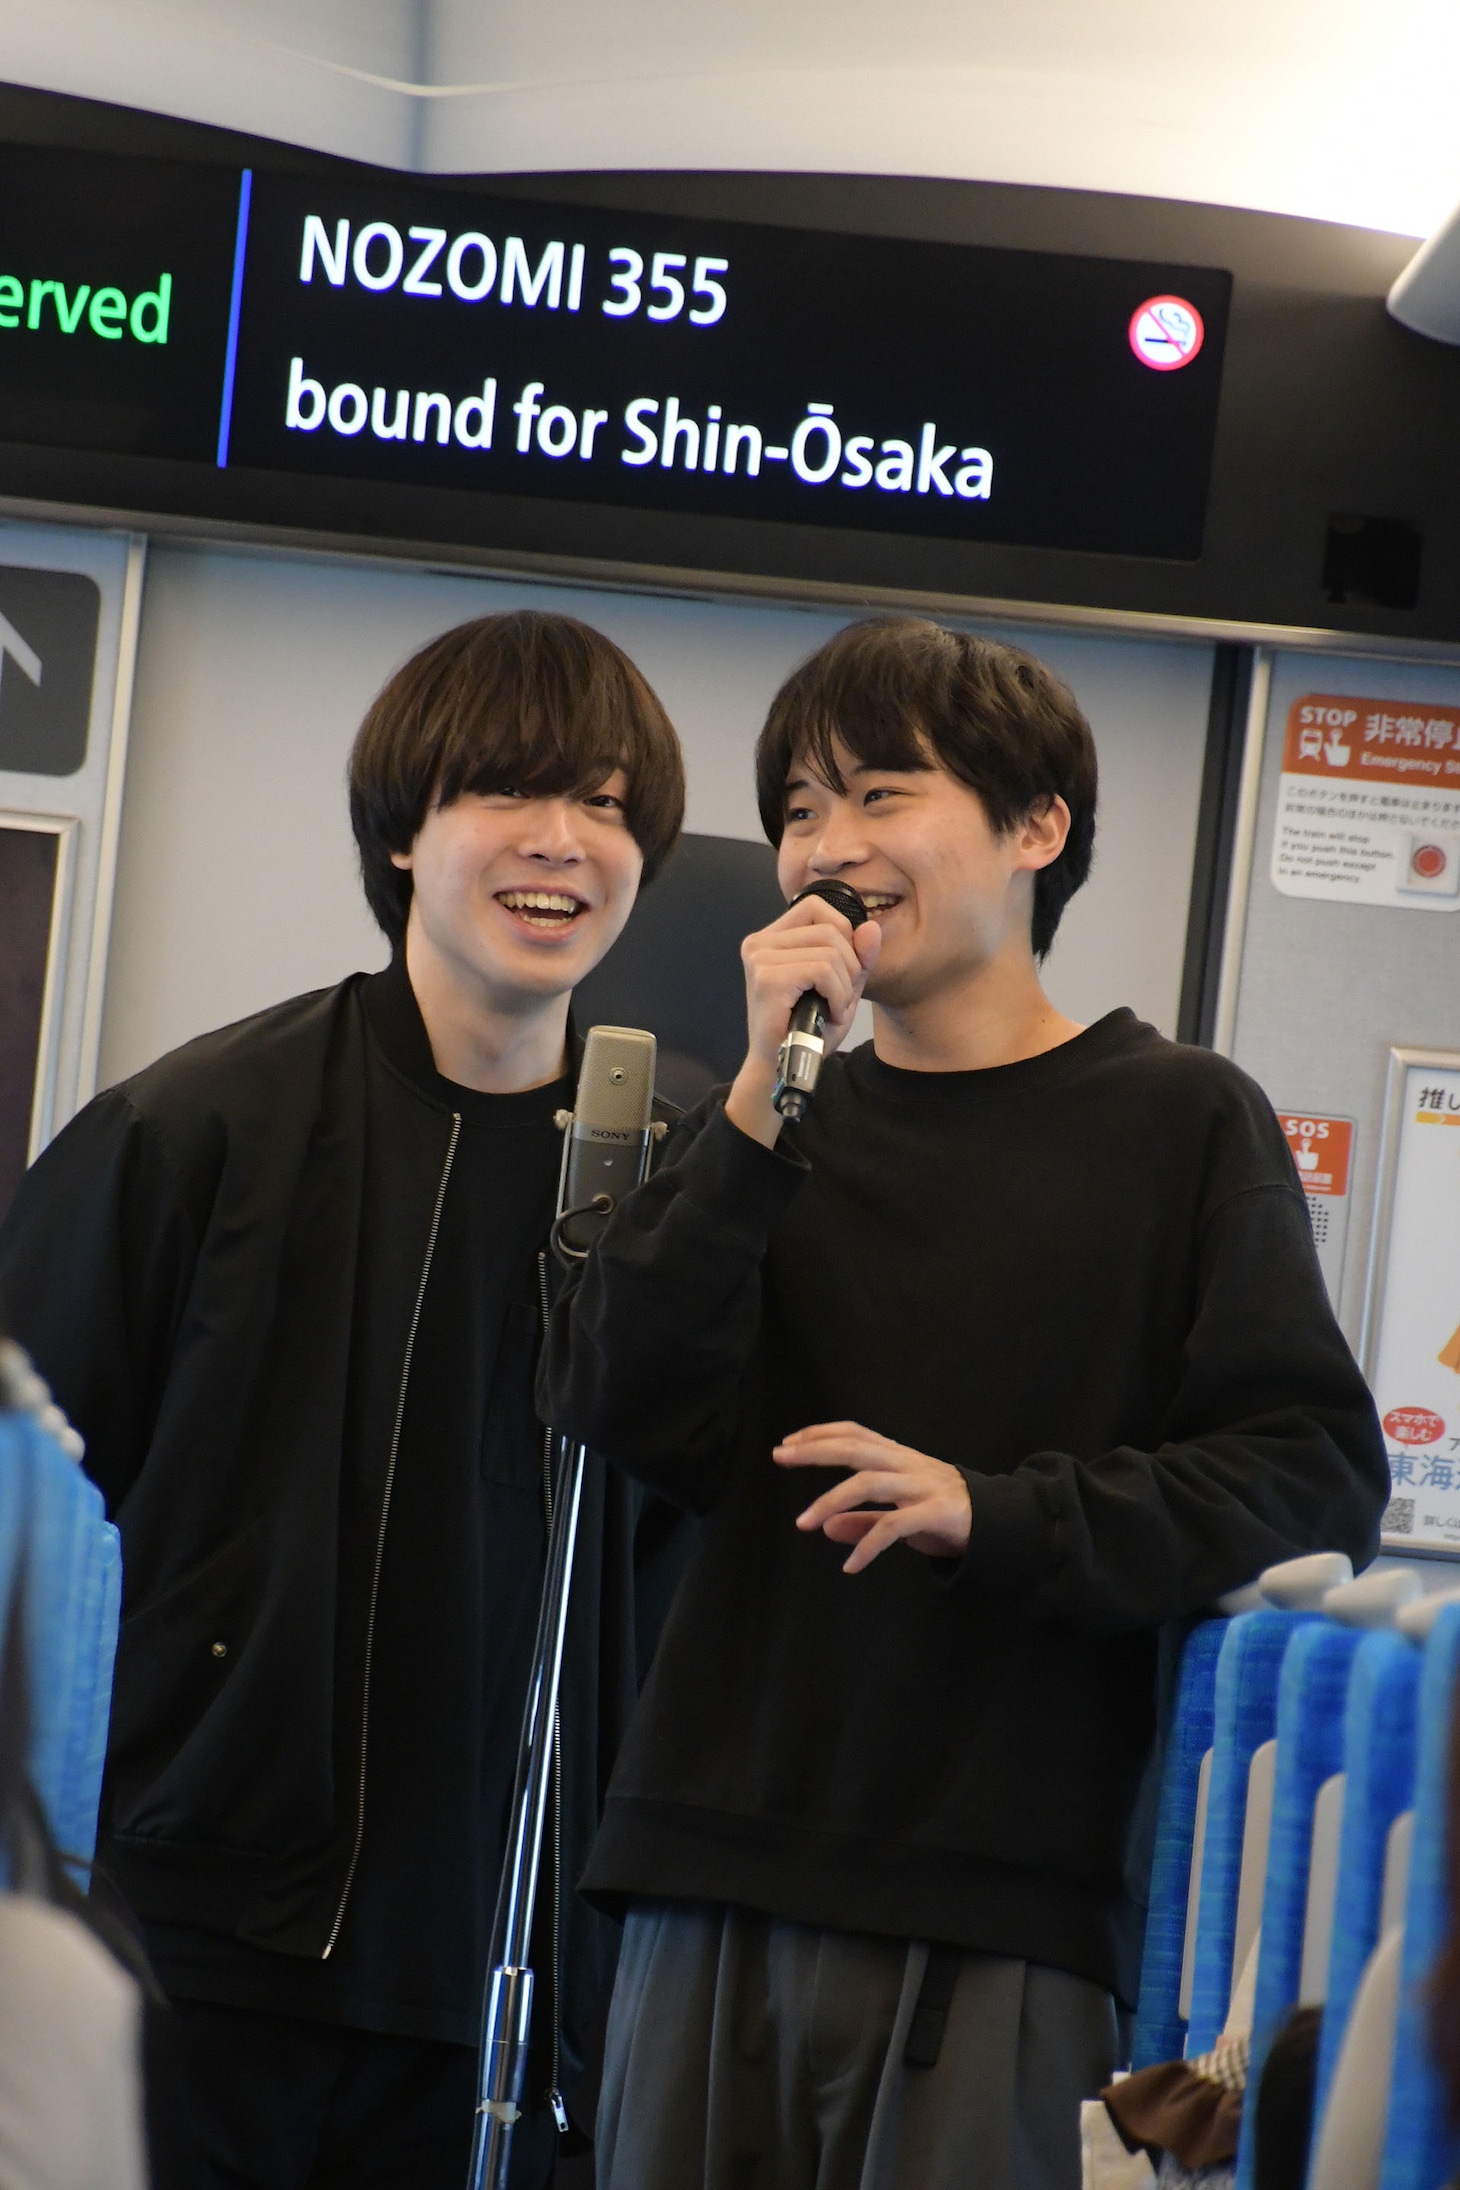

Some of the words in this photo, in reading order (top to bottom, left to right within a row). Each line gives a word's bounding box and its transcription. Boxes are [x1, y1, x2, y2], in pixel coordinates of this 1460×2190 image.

[299, 214, 586, 311] NOZOMI
[602, 247, 729, 325] 355
[0, 273, 173, 344] erved
[285, 357, 497, 449] bound
[513, 382, 609, 459] for
[621, 396, 995, 500] Shin-Ōsaka
[1300, 706, 1358, 727] STOP
[1361, 752, 1442, 776] Emergency
[1283, 826, 1300, 836] The
[1303, 828, 1326, 840] train
[1328, 831, 1346, 840] will
[1348, 835, 1370, 845] stop
[1291, 843, 1309, 851] you
[1312, 845, 1337, 853] push
[1338, 846, 1358, 856] this
[1280, 852, 1294, 862] Do
[1297, 856, 1313, 864] not
[1315, 859, 1339, 867] push
[1342, 861, 1377, 872] except
[1419, 1087, 1460, 1110] 推し
[591, 1129, 631, 1141] SONY
[1286, 1119, 1330, 1139] SOS
[1389, 1411, 1440, 1428] スマホで
[1388, 1452, 1460, 1490] 東海
